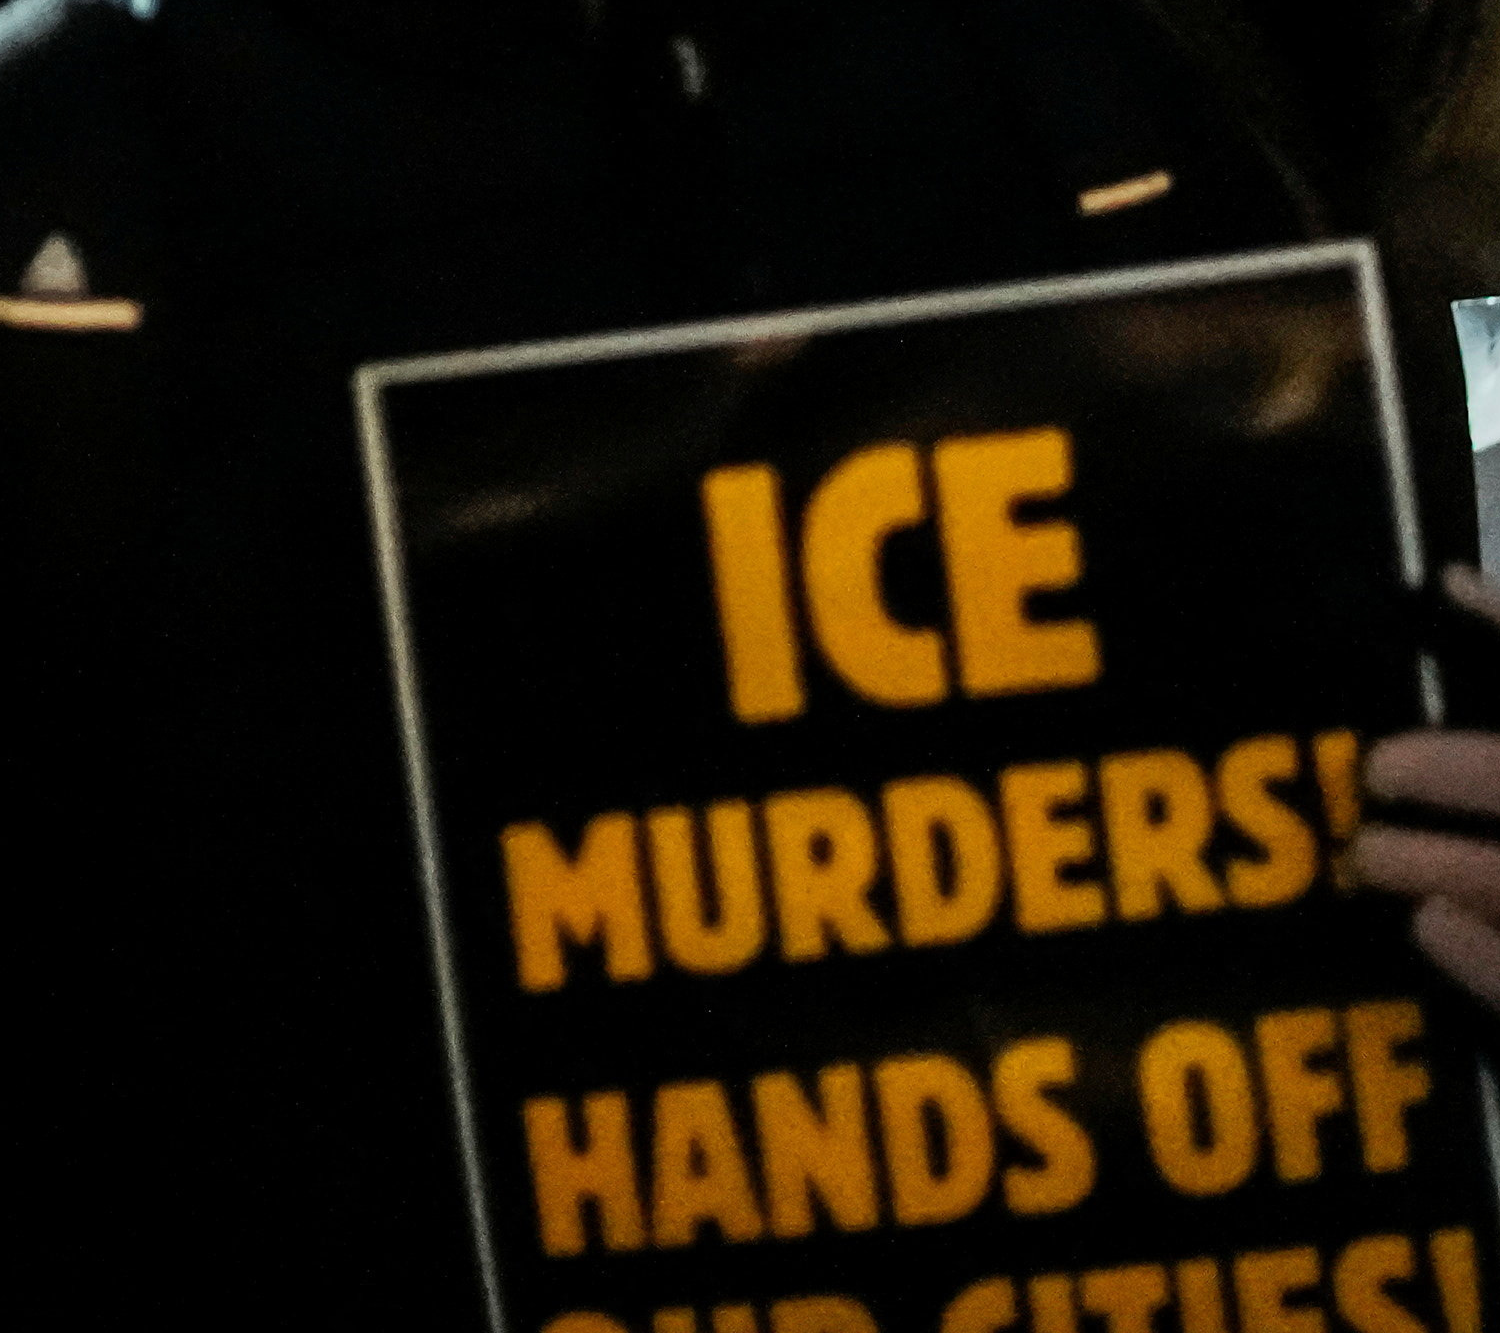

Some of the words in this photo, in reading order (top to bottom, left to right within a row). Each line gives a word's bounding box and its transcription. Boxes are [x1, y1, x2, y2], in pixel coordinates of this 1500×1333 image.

[700, 425, 1101, 724] ICE
[500, 731, 1363, 993] MURDERS!
[522, 1035, 1096, 1256] HANDS
[1136, 1001, 1432, 1196] OFF
